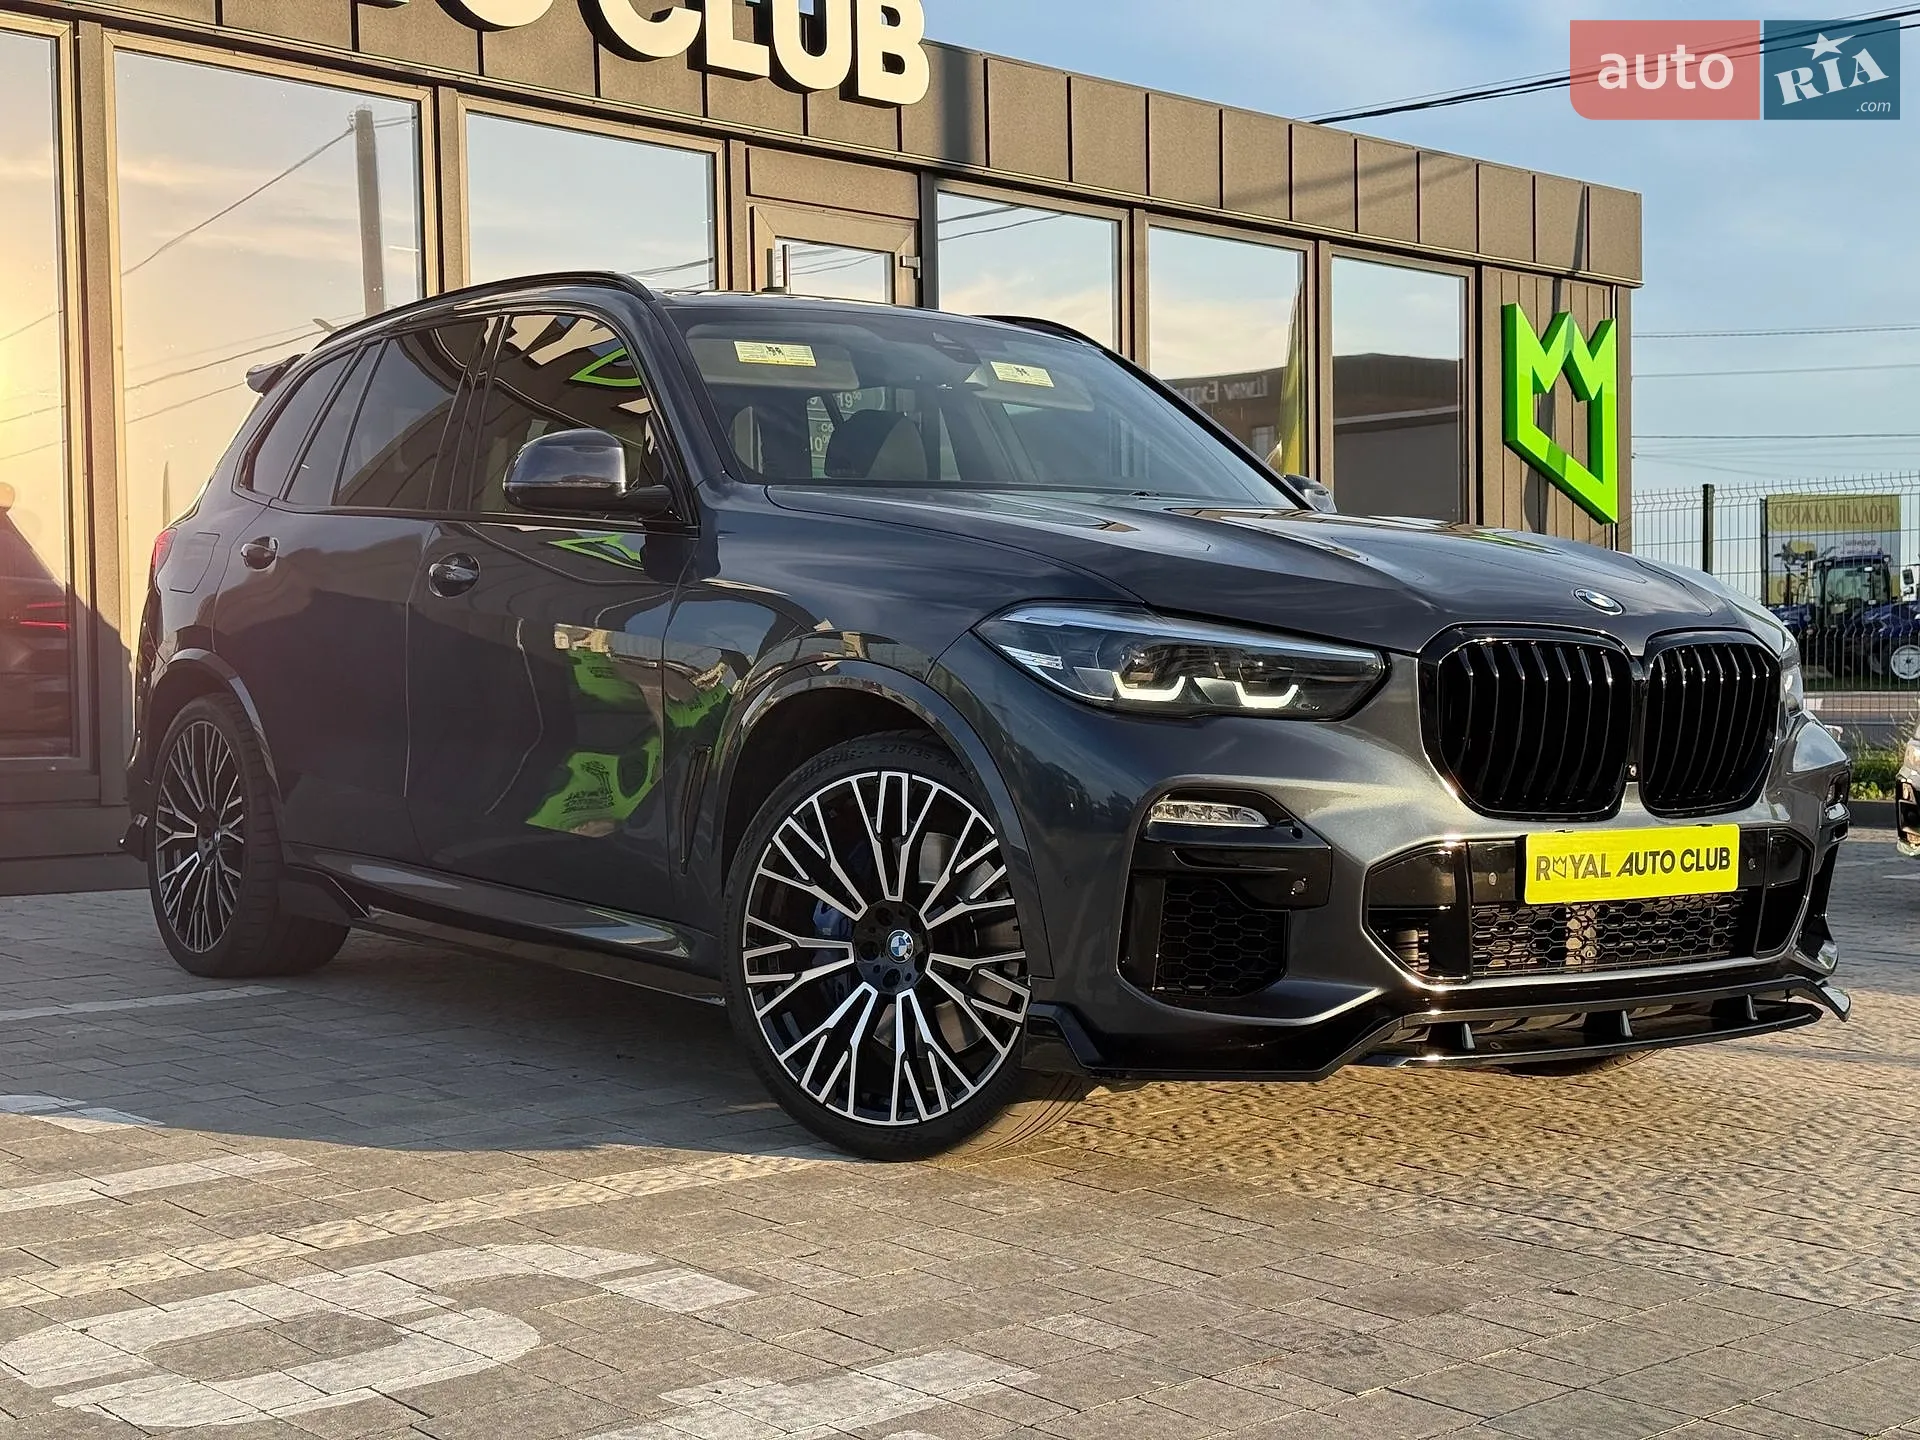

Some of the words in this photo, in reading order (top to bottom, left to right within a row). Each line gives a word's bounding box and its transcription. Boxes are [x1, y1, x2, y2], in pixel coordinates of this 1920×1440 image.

[1774, 504, 1833, 525] СТЯЖКА
[1616, 848, 1676, 877] AUTO
[1679, 846, 1731, 872] CLUB
